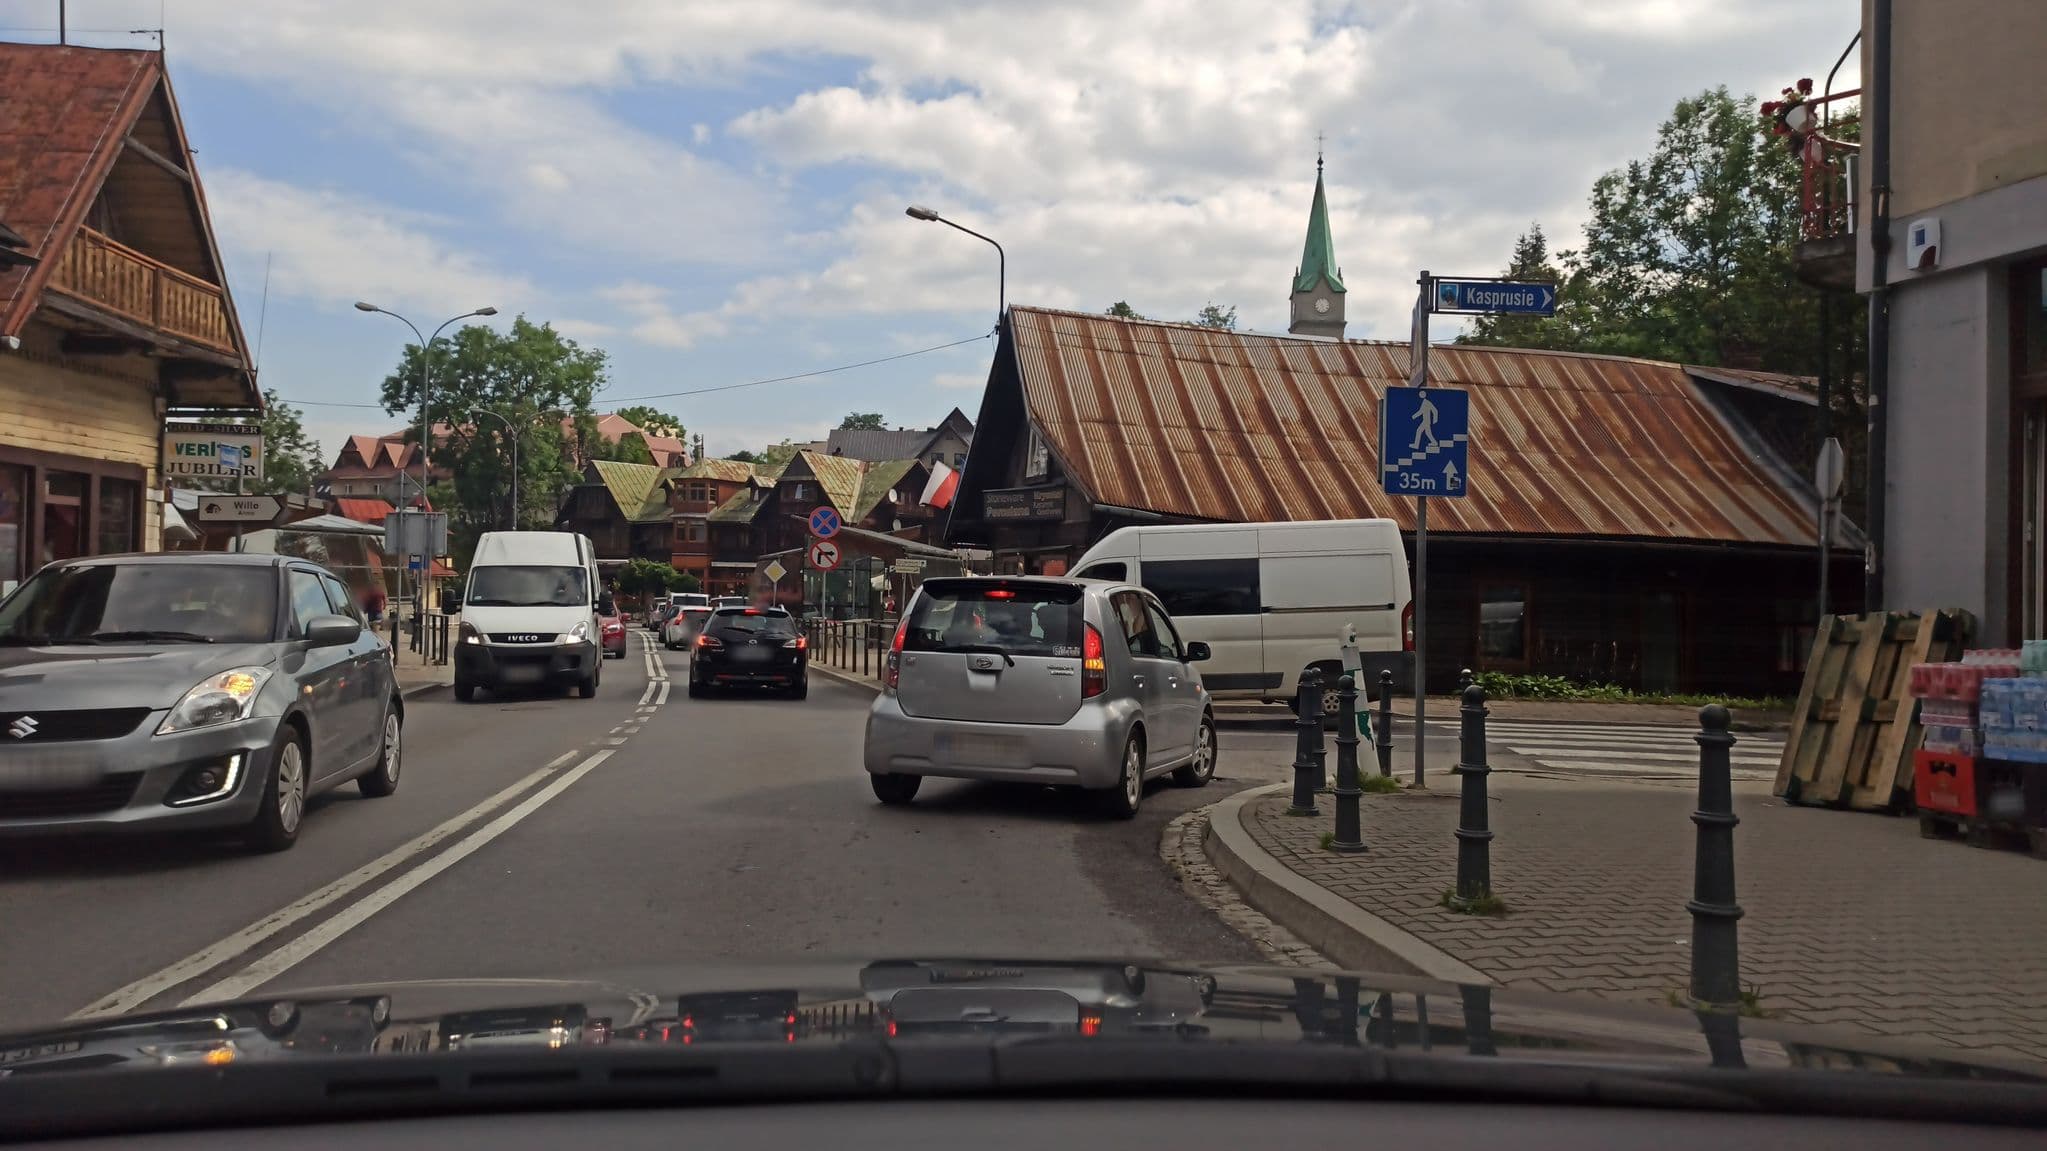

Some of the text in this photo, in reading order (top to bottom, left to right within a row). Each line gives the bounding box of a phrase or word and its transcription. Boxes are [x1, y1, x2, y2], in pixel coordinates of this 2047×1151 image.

[1467, 288, 1534, 308] Kasprusie
[213, 425, 258, 434] SILVER
[175, 441, 252, 459] VERIS
[1399, 473, 1436, 490] 35m
[234, 501, 259, 509] Willa
